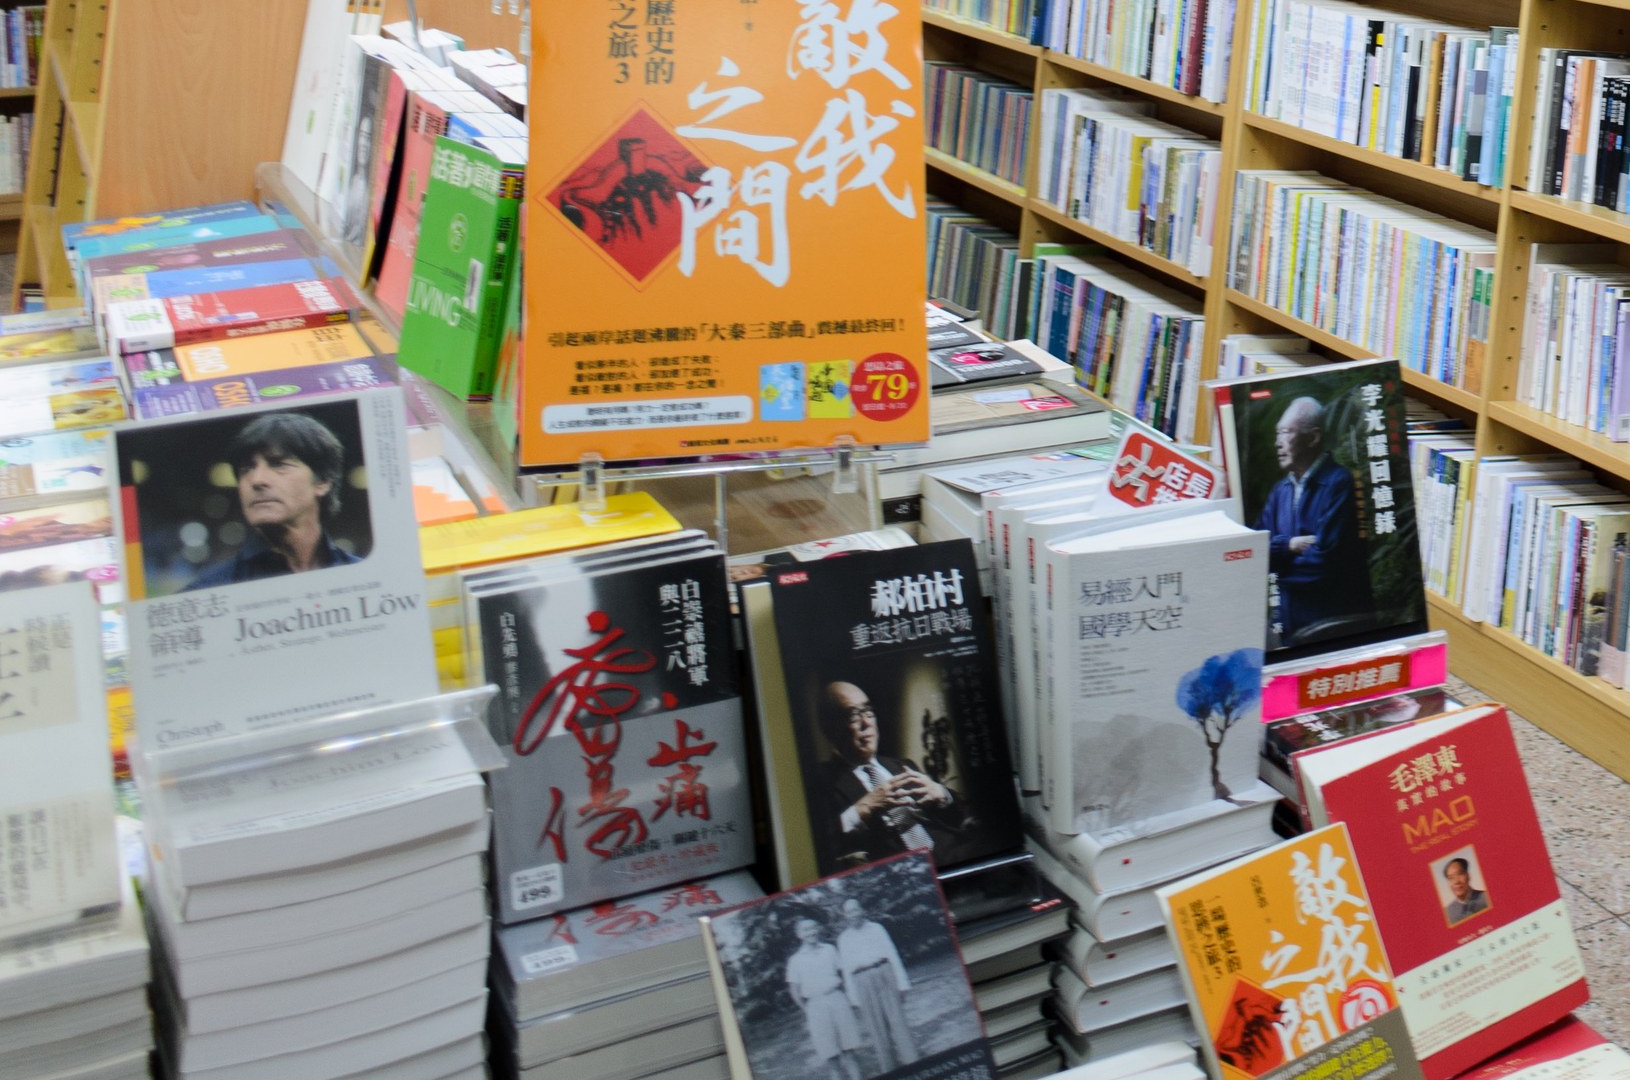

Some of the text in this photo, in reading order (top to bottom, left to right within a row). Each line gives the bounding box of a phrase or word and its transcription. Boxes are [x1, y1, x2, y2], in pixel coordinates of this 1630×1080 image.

[676, 56, 798, 288] 之間
[406, 276, 462, 328] LIVING
[866, 373, 909, 401] 79
[1159, 460, 1215, 499] 店長
[1360, 383, 1398, 535] 李光耀回憶錄
[870, 568, 965, 618] 郝柏村
[1079, 571, 1183, 607] 易經入門
[234, 592, 421, 643] Joachim Löw
[659, 583, 687, 672] 與二二八
[850, 607, 973, 651] 重返抗日戰場
[1079, 606, 1184, 641] 國學天空
[1306, 660, 1403, 700] 特別推薦
[1387, 744, 1463, 793] 毛澤東
[1402, 794, 1477, 845] MAO
[1288, 841, 1390, 993] 敵我
[1260, 930, 1341, 1061] 之間
